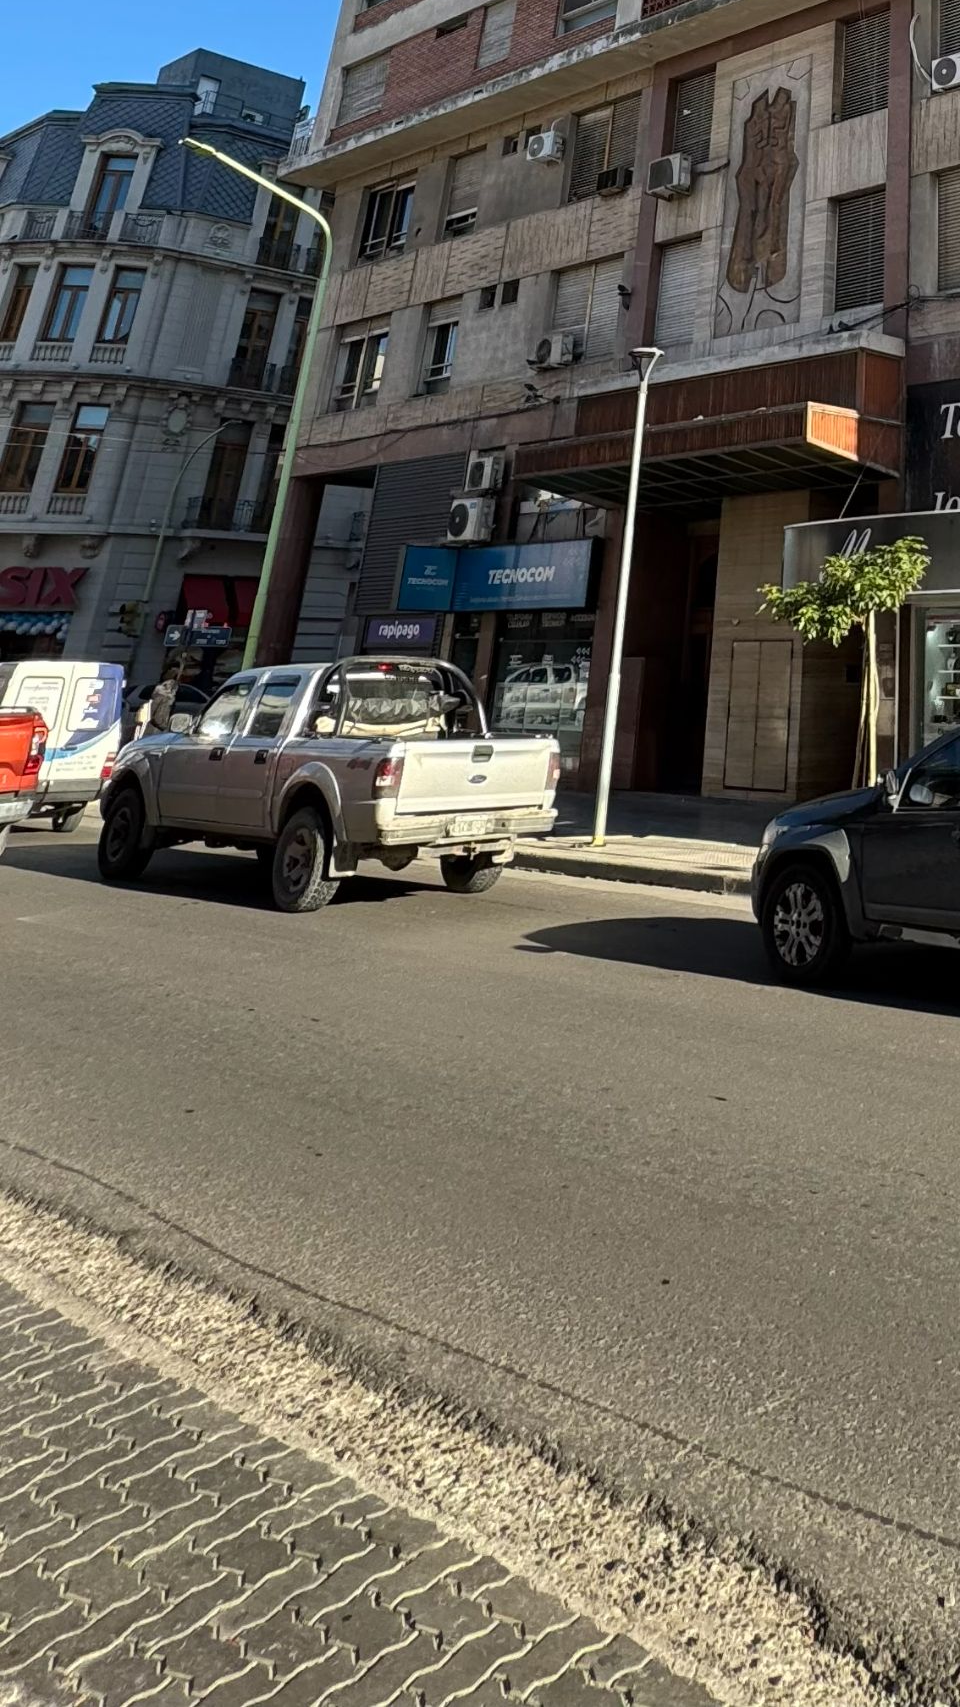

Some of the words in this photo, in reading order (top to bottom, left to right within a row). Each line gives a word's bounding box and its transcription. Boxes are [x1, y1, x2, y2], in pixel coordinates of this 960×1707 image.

[407, 577, 449, 587] TECNOCOM
[487, 565, 556, 585] TECNOCOM
[0, 566, 91, 607] SIX
[378, 619, 420, 639] rapipago
